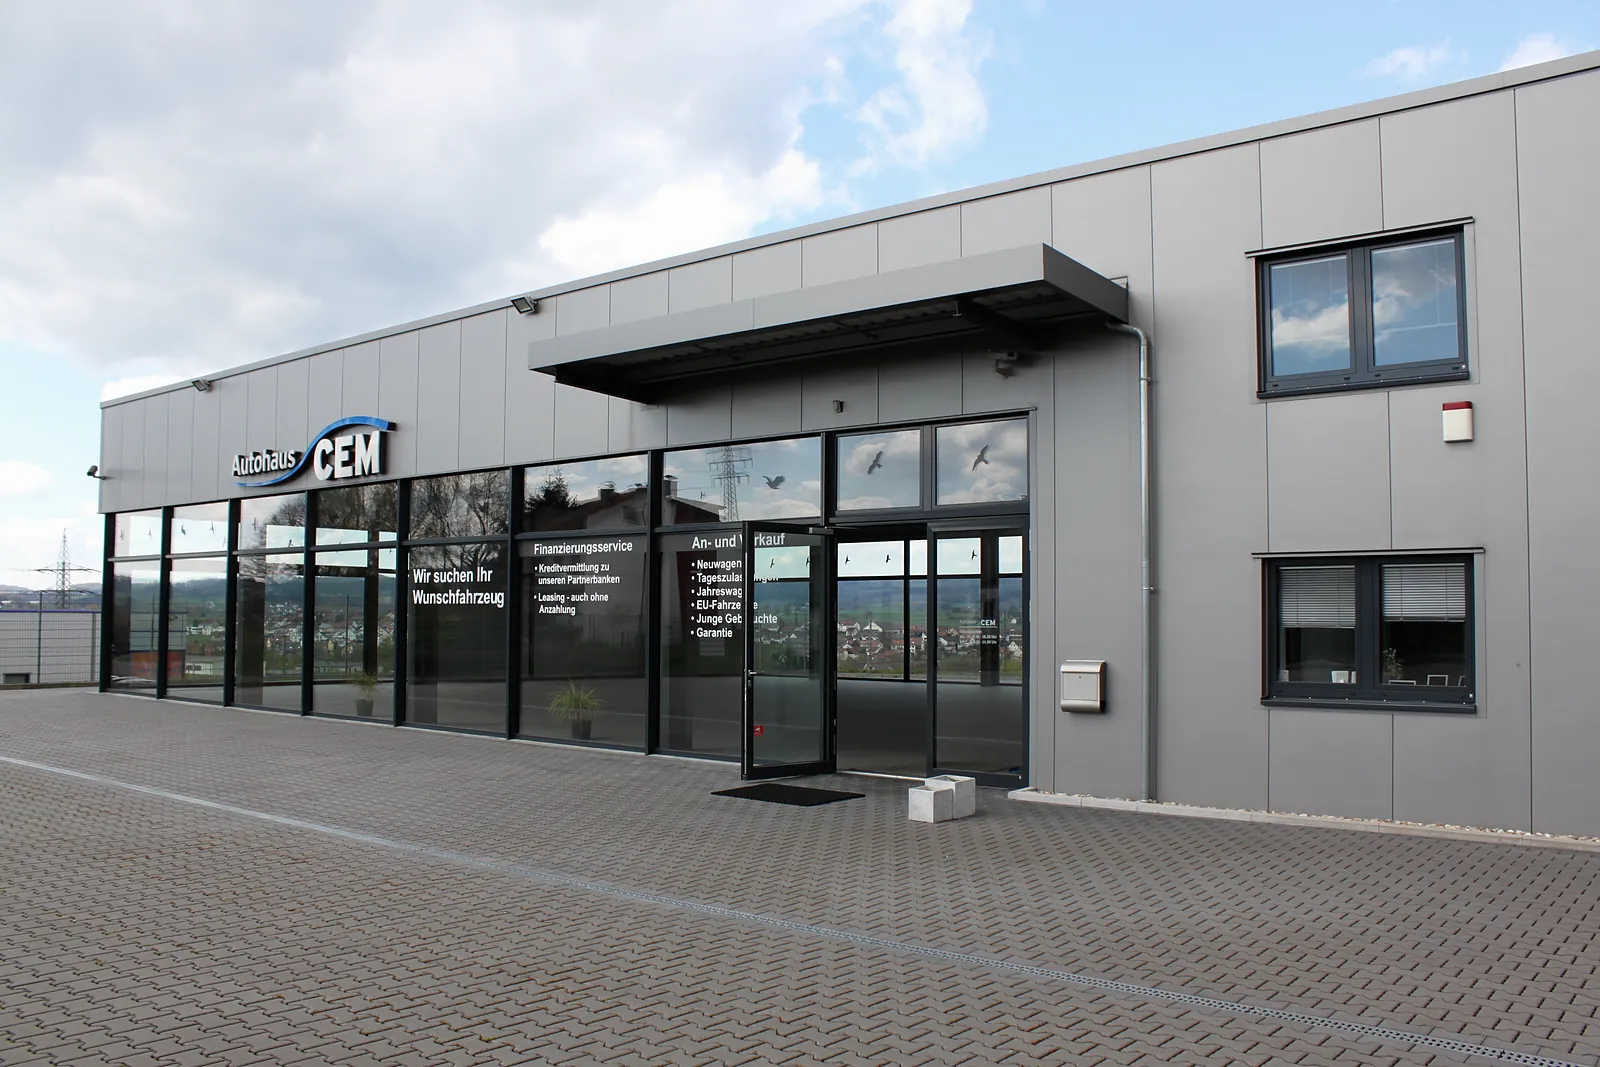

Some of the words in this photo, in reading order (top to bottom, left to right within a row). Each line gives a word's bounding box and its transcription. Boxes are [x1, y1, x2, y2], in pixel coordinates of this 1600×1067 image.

[314, 430, 380, 480] CEM
[232, 450, 296, 476] Autohaus
[692, 536, 712, 549] An-
[714, 535, 736, 548] und
[740, 532, 786, 548] rkauf
[534, 540, 633, 555] Finanzierungsservice
[538, 563, 599, 573] Kreditvermittlung
[601, 564, 610, 572] zu
[696, 560, 742, 570] Neuwagen
[413, 568, 430, 584] Wir
[434, 568, 474, 583] suchen
[477, 567, 493, 582] Ihr
[538, 576, 566, 584] unseren
[568, 574, 620, 584] Partnerbanken
[538, 592, 565, 603] Leasing
[571, 592, 588, 602] auch
[590, 592, 608, 602] ohne
[696, 586, 742, 598] Jahreswag
[412, 590, 505, 608] Wunschfahrzeug
[696, 600, 758, 610] EU-Fahrzee
[538, 604, 576, 616] Anzahlung
[696, 614, 722, 626] Junge
[726, 612, 778, 624] Gebuchte
[696, 628, 732, 638] Garantie
